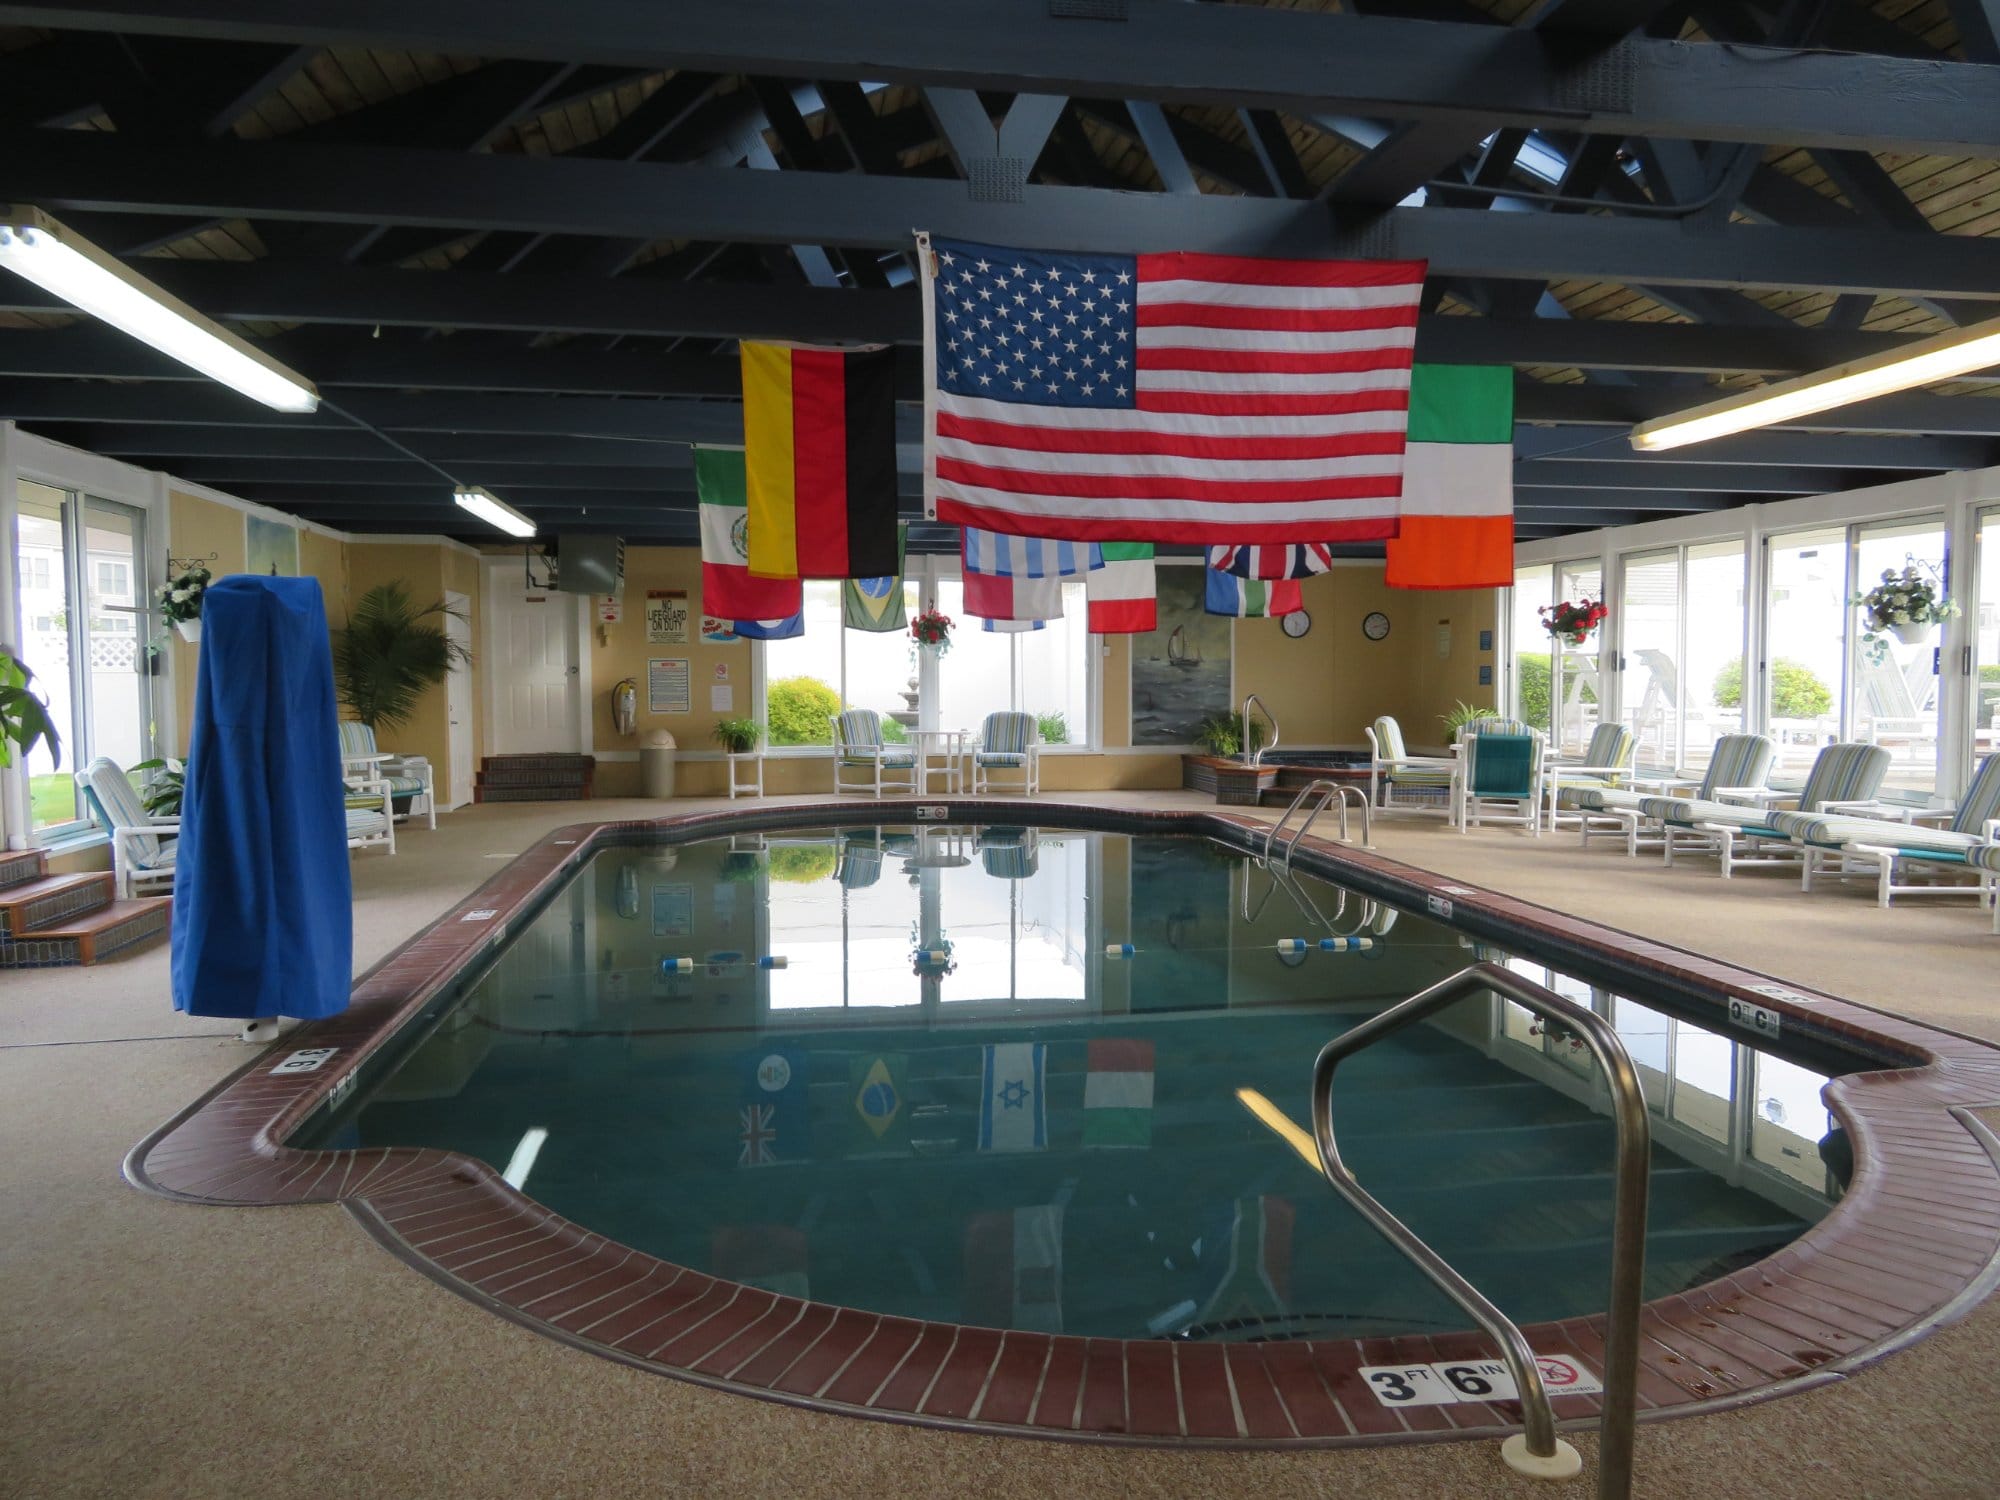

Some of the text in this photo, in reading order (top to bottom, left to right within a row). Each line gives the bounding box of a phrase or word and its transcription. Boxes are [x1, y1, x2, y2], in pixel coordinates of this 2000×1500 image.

[662, 600, 672, 609] NO
[648, 609, 686, 620] LIFEGUARD
[652, 620, 682, 631] ON DUTY
[284, 1060, 317, 1068] 6
[1371, 1365, 1505, 1400] 3 FT 6 IN
